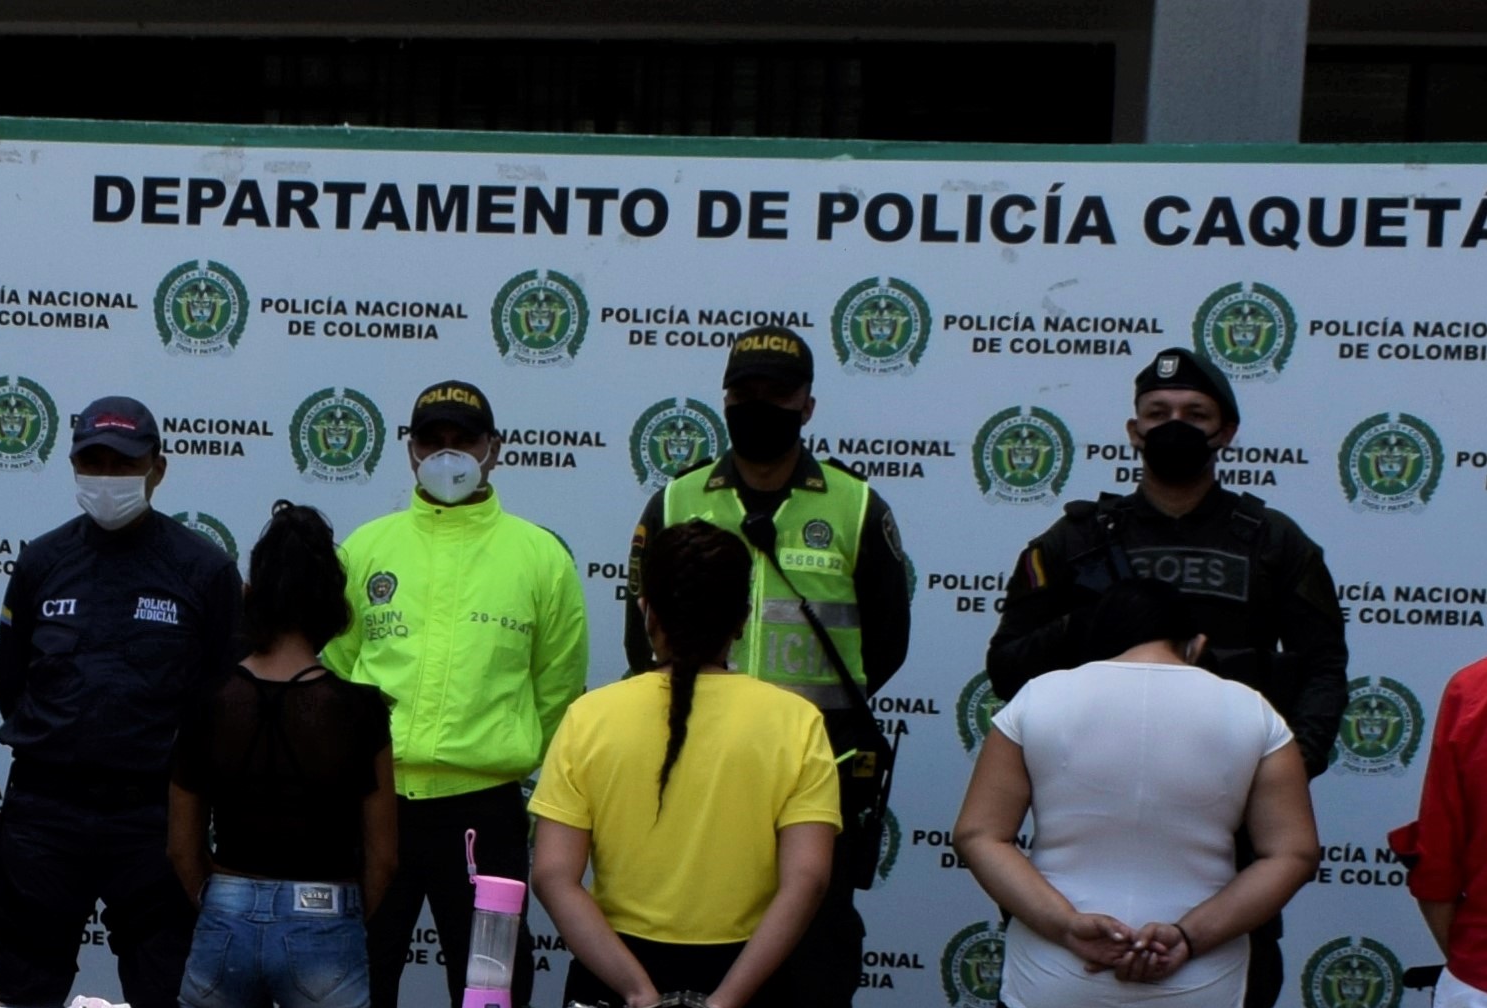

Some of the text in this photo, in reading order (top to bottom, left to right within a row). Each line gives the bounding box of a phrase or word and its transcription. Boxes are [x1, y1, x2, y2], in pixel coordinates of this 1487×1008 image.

[92, 174, 670, 238] DEPARTAMENTO
[696, 189, 790, 241] DE
[816, 183, 1117, 246] POLICÍA
[28, 290, 138, 309] NACIONAL
[260, 296, 468, 319] POLICÍA NACIONAL
[601, 305, 815, 328] POLICÍA NACIONAL
[944, 312, 1164, 334] POLICÍA NACIONAL
[288, 320, 439, 339] DE COLOMBIA
[1309, 317, 1405, 337] POLICÍA
[629, 330, 736, 348] DE COLOM
[972, 337, 1132, 356] DE COLOMBIA
[1339, 343, 1369, 359] DE
[163, 417, 274, 437] NACIONAL
[162, 437, 245, 457] LOMBIA
[495, 429, 606, 448] NACIONAL
[839, 439, 955, 457] NACIONAL
[495, 450, 576, 468] LOMBIA
[1087, 444, 1308, 465] POLI CIONAL
[847, 460, 924, 478] OMBIA
[1116, 467, 1277, 486] DE MBIA
[1337, 583, 1384, 602] ICÍA
[41, 598, 77, 617] CTI
[957, 597, 985, 612] DE
[133, 608, 178, 624] JUDICIAL
[1359, 608, 1485, 626] COLOMBIA
[872, 697, 940, 714] IONAL
[1321, 843, 1367, 863] ICÍA
[1341, 869, 1407, 886] COLO
[863, 952, 924, 968] ONAL
